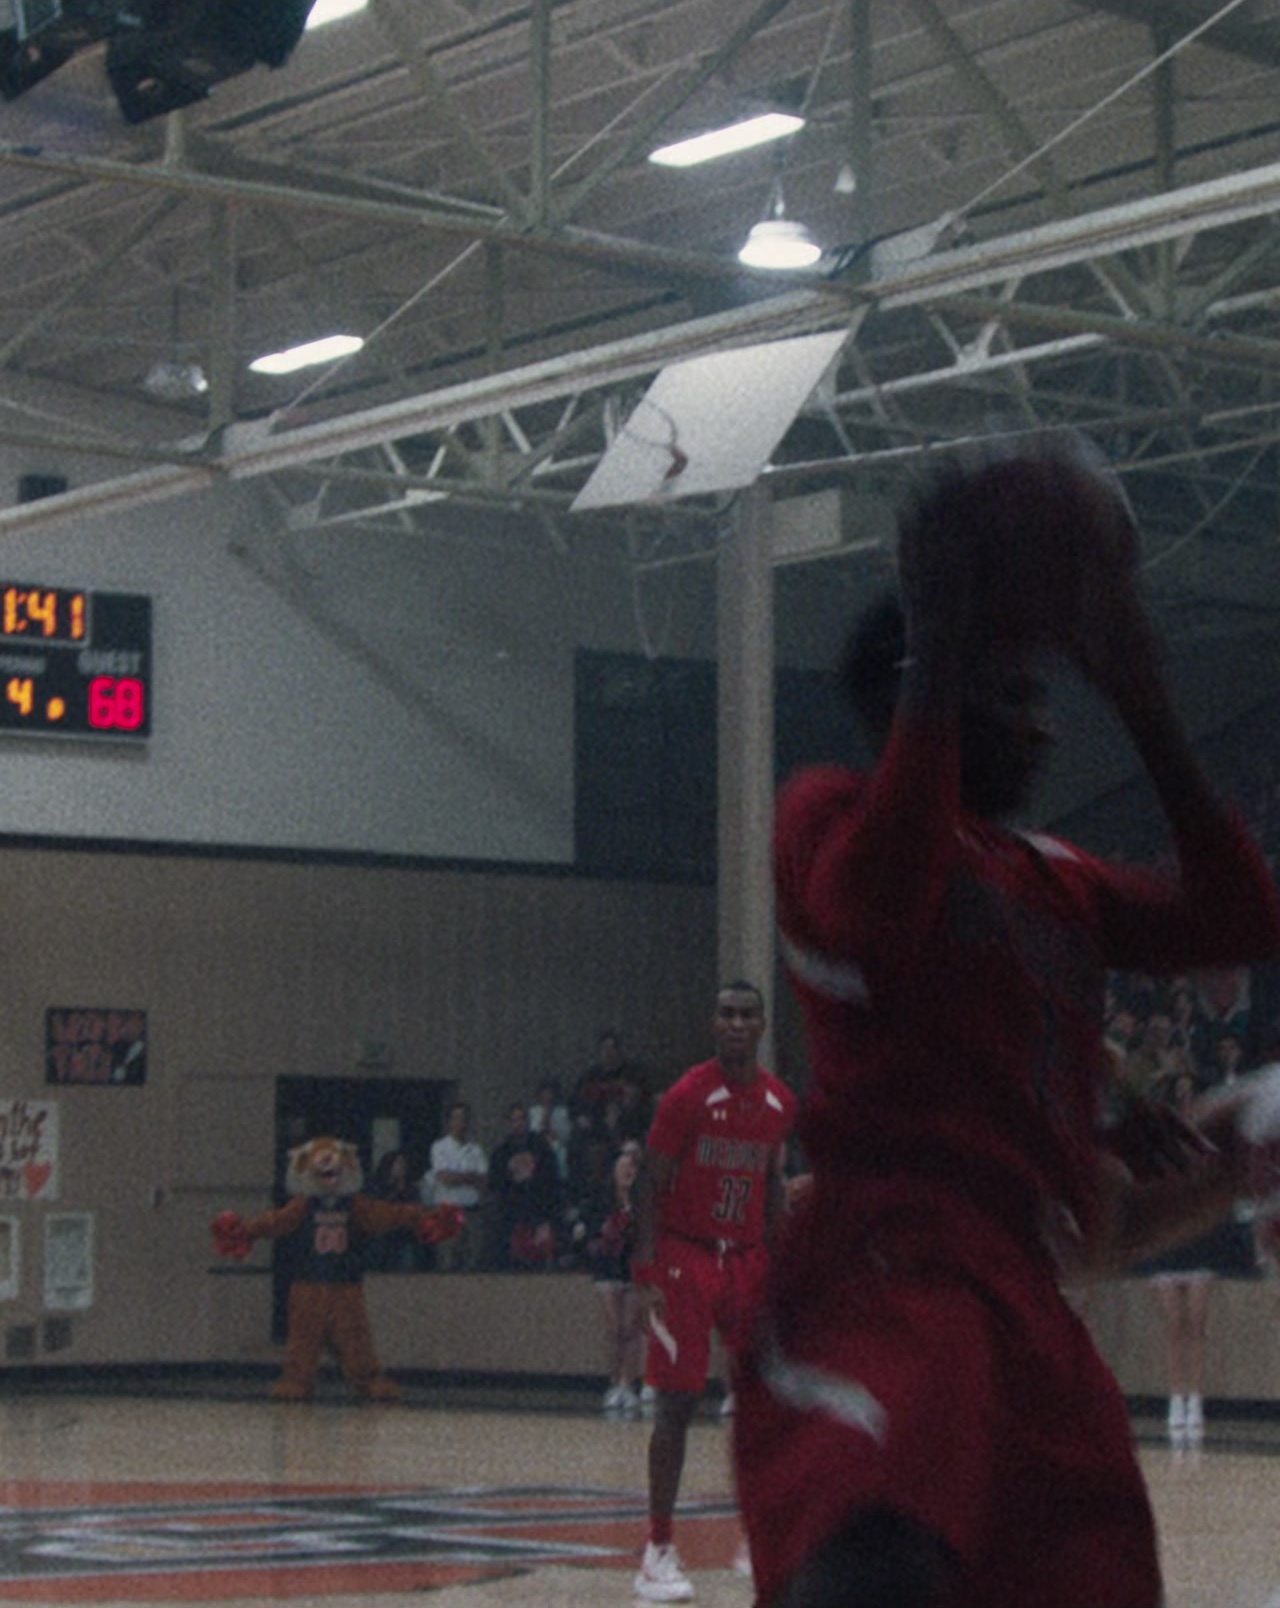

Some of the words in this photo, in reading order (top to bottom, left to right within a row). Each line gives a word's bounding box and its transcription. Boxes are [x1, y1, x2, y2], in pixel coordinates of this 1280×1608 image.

[77, 650, 142, 676] GUEST
[7, 678, 33, 716] 4
[88, 676, 144, 731] 68
[712, 1175, 751, 1222] 32
